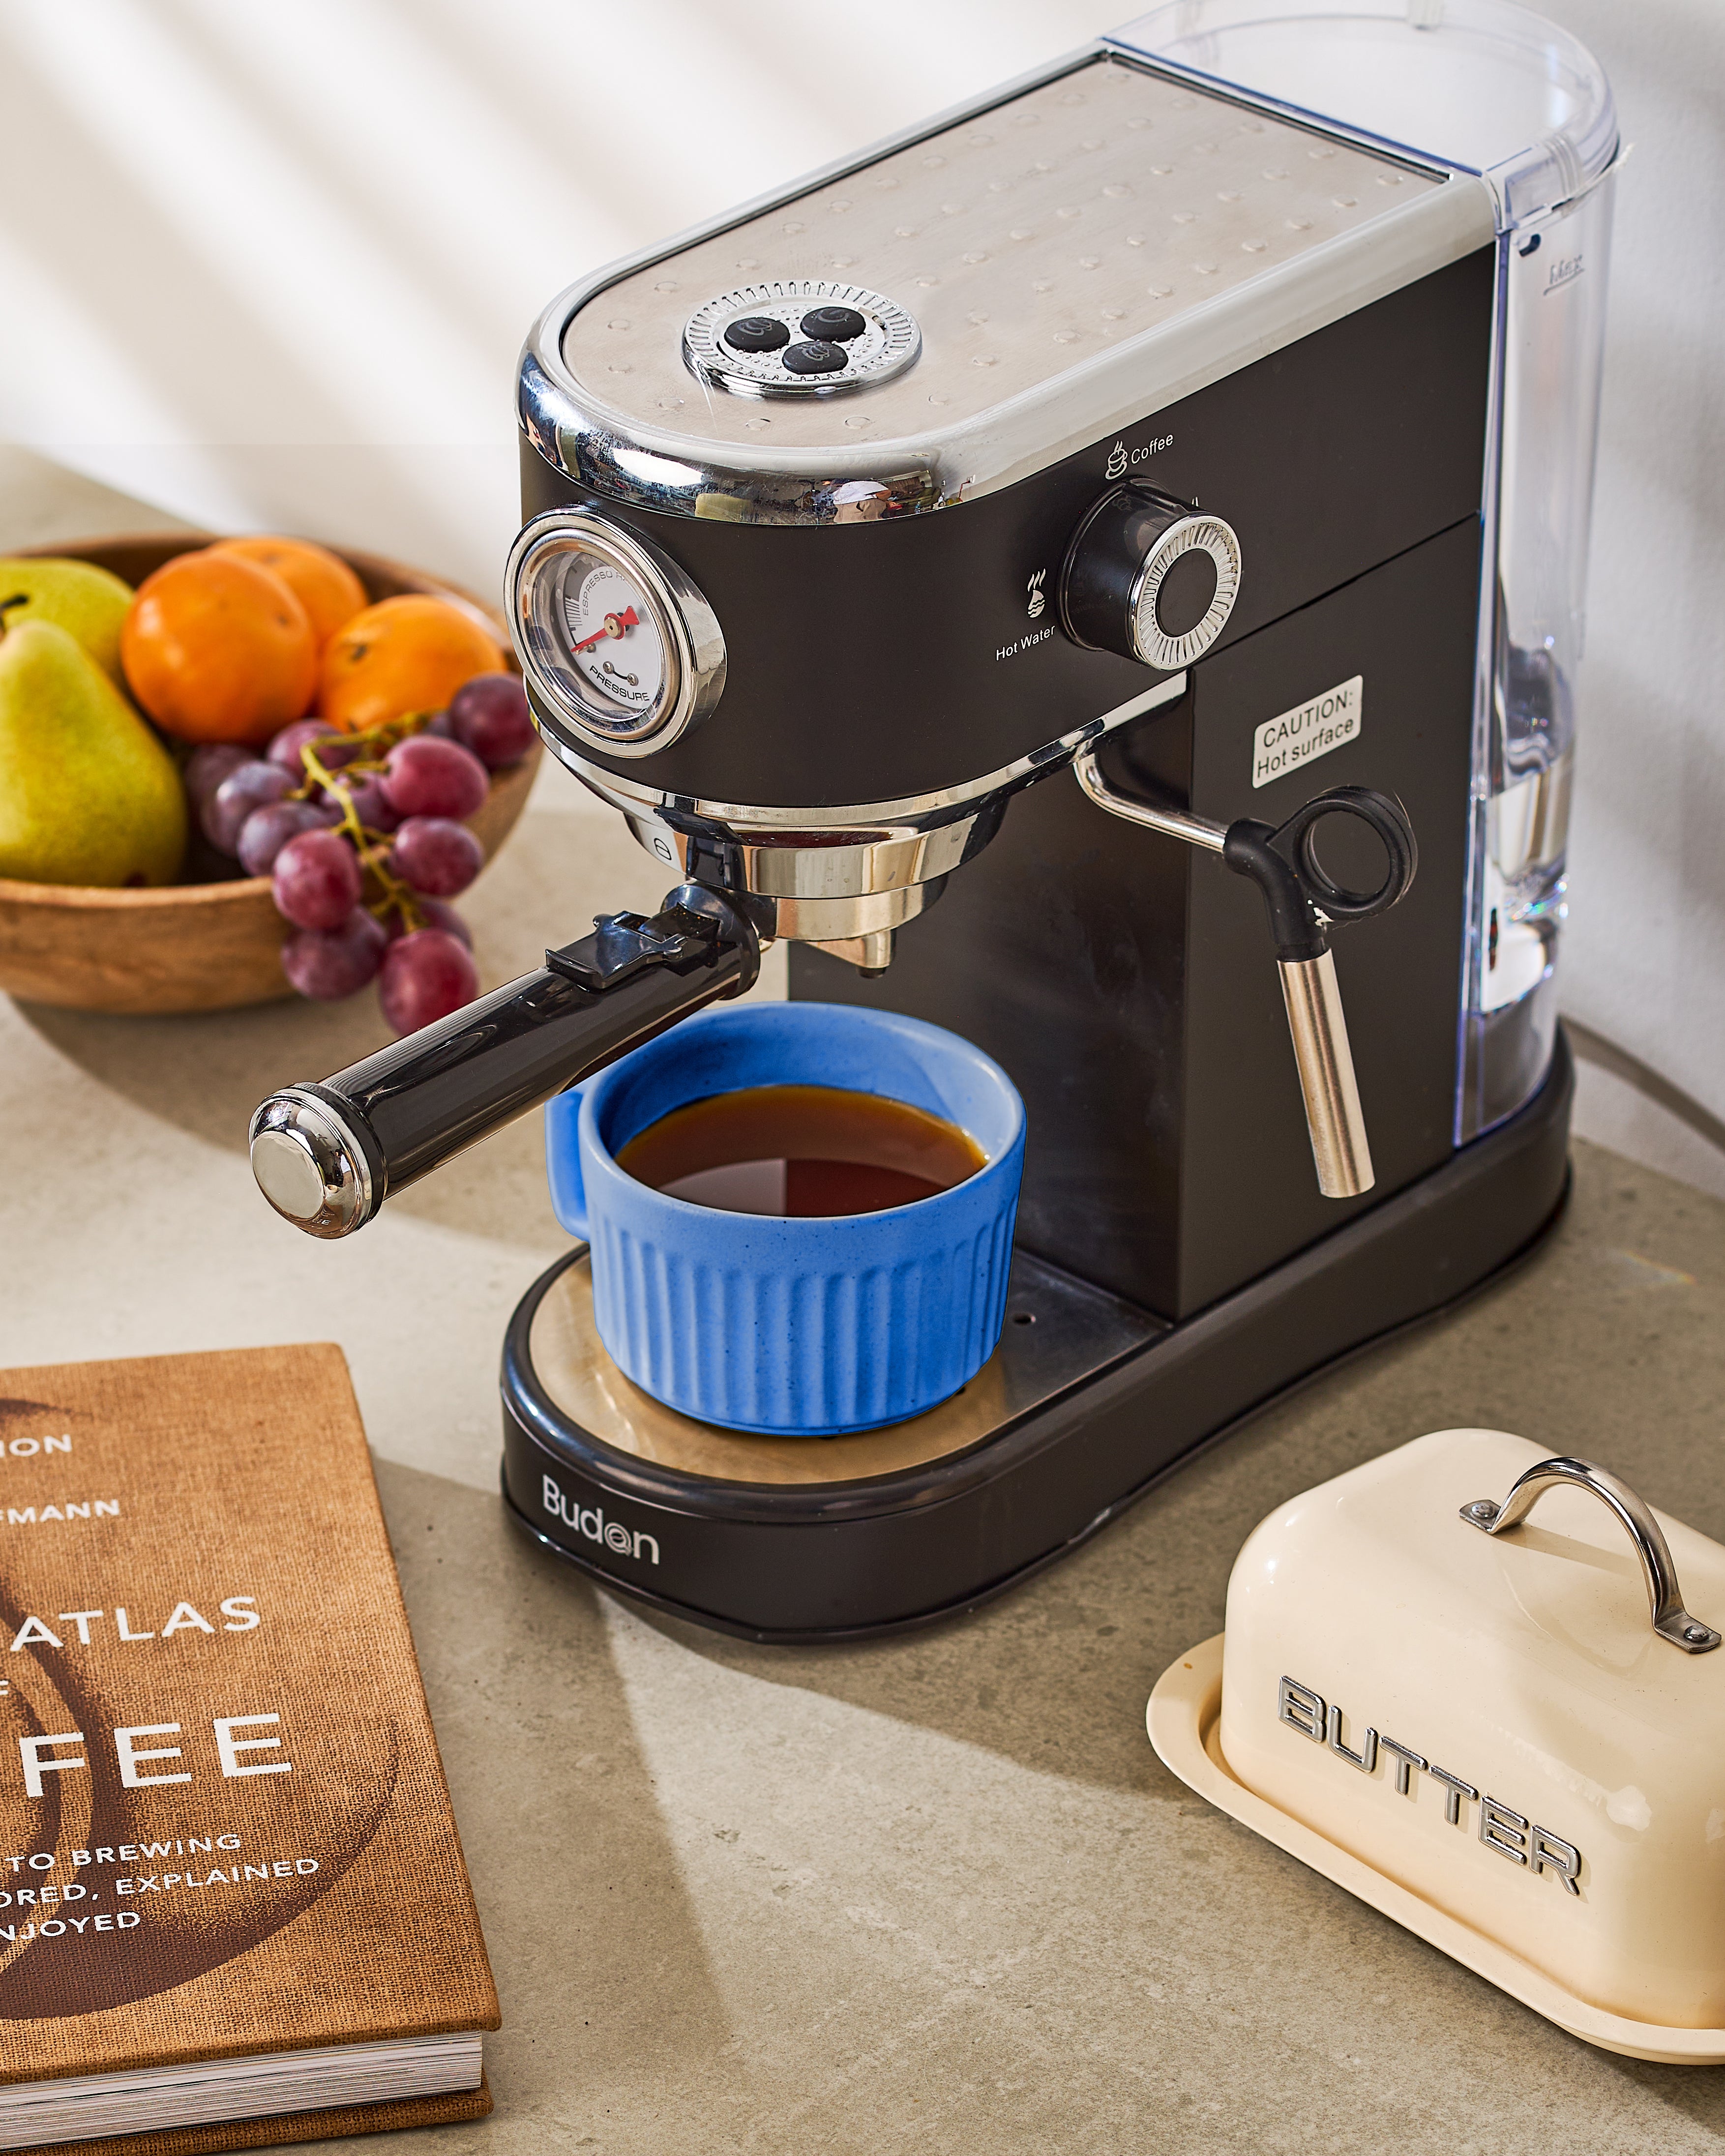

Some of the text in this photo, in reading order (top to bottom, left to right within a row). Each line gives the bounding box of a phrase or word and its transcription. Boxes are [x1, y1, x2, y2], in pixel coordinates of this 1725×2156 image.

[1131, 434, 1174, 464] Coffee
[583, 570, 613, 616] ESPRESSO
[996, 625, 1055, 661] Hot Water
[590, 665, 650, 701] PRESSURE
[1263, 690, 1353, 747] CAUTION:
[1257, 718, 1353, 778] Hot surface
[10, 1596, 261, 1651] ATLAS
[19, 1713, 292, 1798] FEE
[1278, 1675, 1582, 1896] BUTTER
[5, 1833, 241, 1872] TO BREWING
[116, 1859, 319, 1895] EXPLAINED
